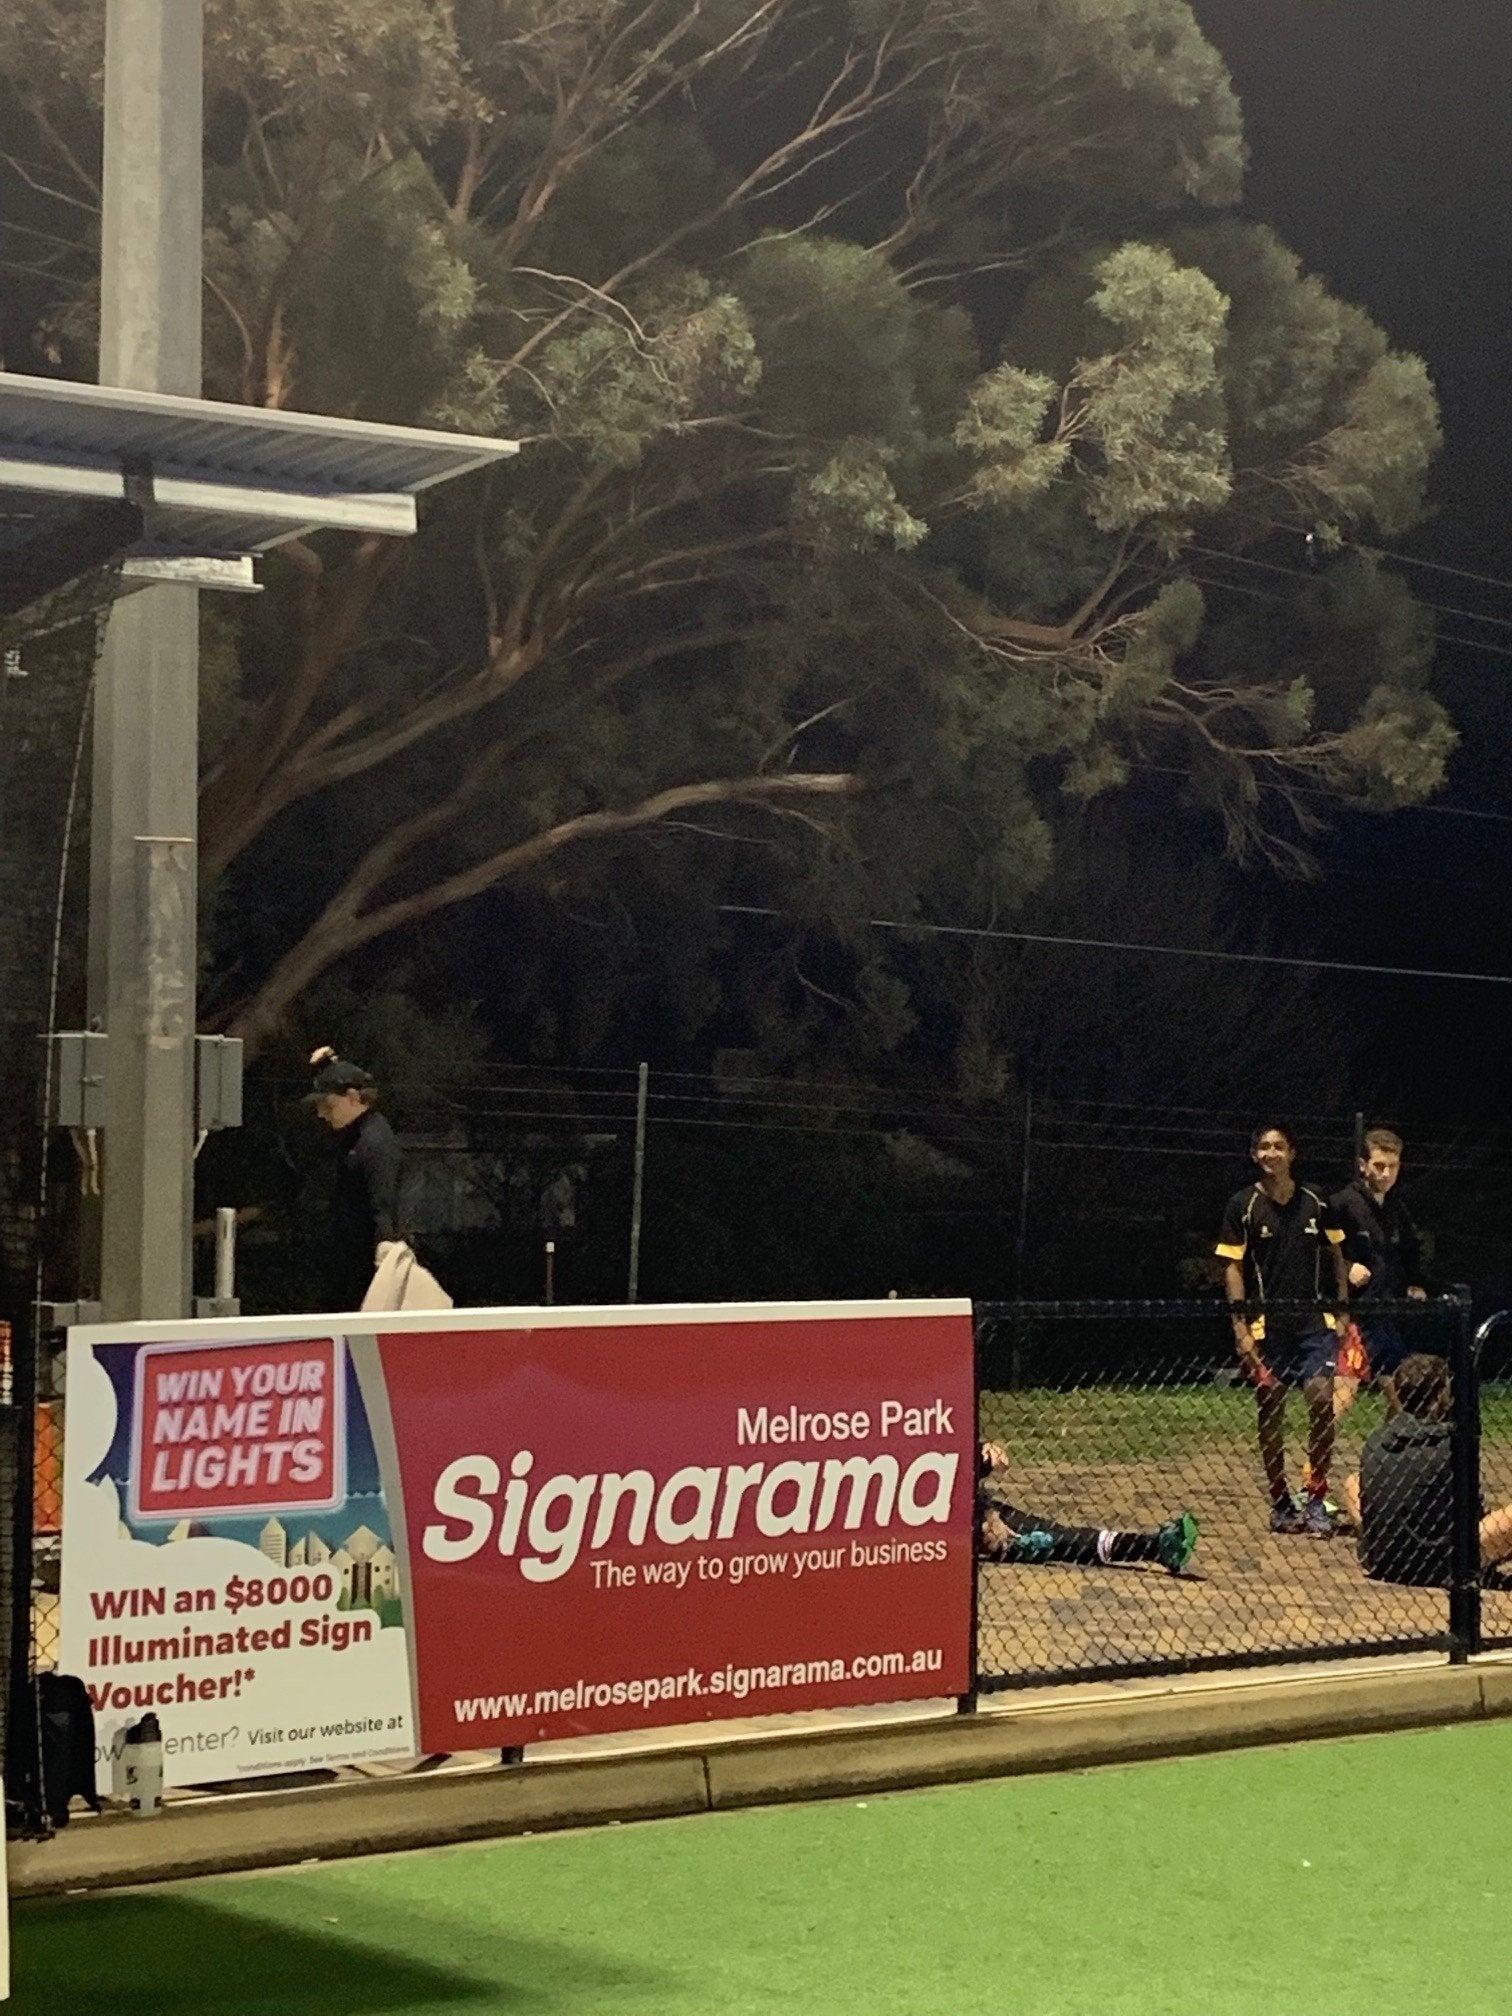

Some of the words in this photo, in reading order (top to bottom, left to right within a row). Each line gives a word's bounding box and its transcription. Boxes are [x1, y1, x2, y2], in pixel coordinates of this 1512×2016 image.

[156, 1368, 224, 1406] WIN
[231, 1360, 325, 1397] YOUR
[153, 1400, 272, 1444] NAME
[279, 1396, 324, 1435] IN
[738, 1407, 870, 1445] Melrose
[881, 1399, 954, 1437] Park
[151, 1439, 325, 1492] LIGHTS
[423, 1450, 960, 1583] Signarama
[590, 1560, 636, 1588] The
[643, 1560, 691, 1589] way
[697, 1556, 724, 1580] to
[728, 1552, 787, 1584] grow
[794, 1546, 844, 1578] your
[851, 1537, 948, 1567] business
[90, 1587, 166, 1620] WIN
[174, 1588, 216, 1614] an
[224, 1574, 333, 1615] $8000
[88, 1620, 291, 1667] Illuminated
[300, 1614, 372, 1651] Sign
[454, 1649, 943, 1722] www.melrosepark.signarama.com.au
[165, 1725, 240, 1755] enter?
[248, 1723, 284, 1746] Visit
[288, 1726, 316, 1742] our
[319, 1717, 383, 1739] website
[387, 1715, 404, 1731] at
